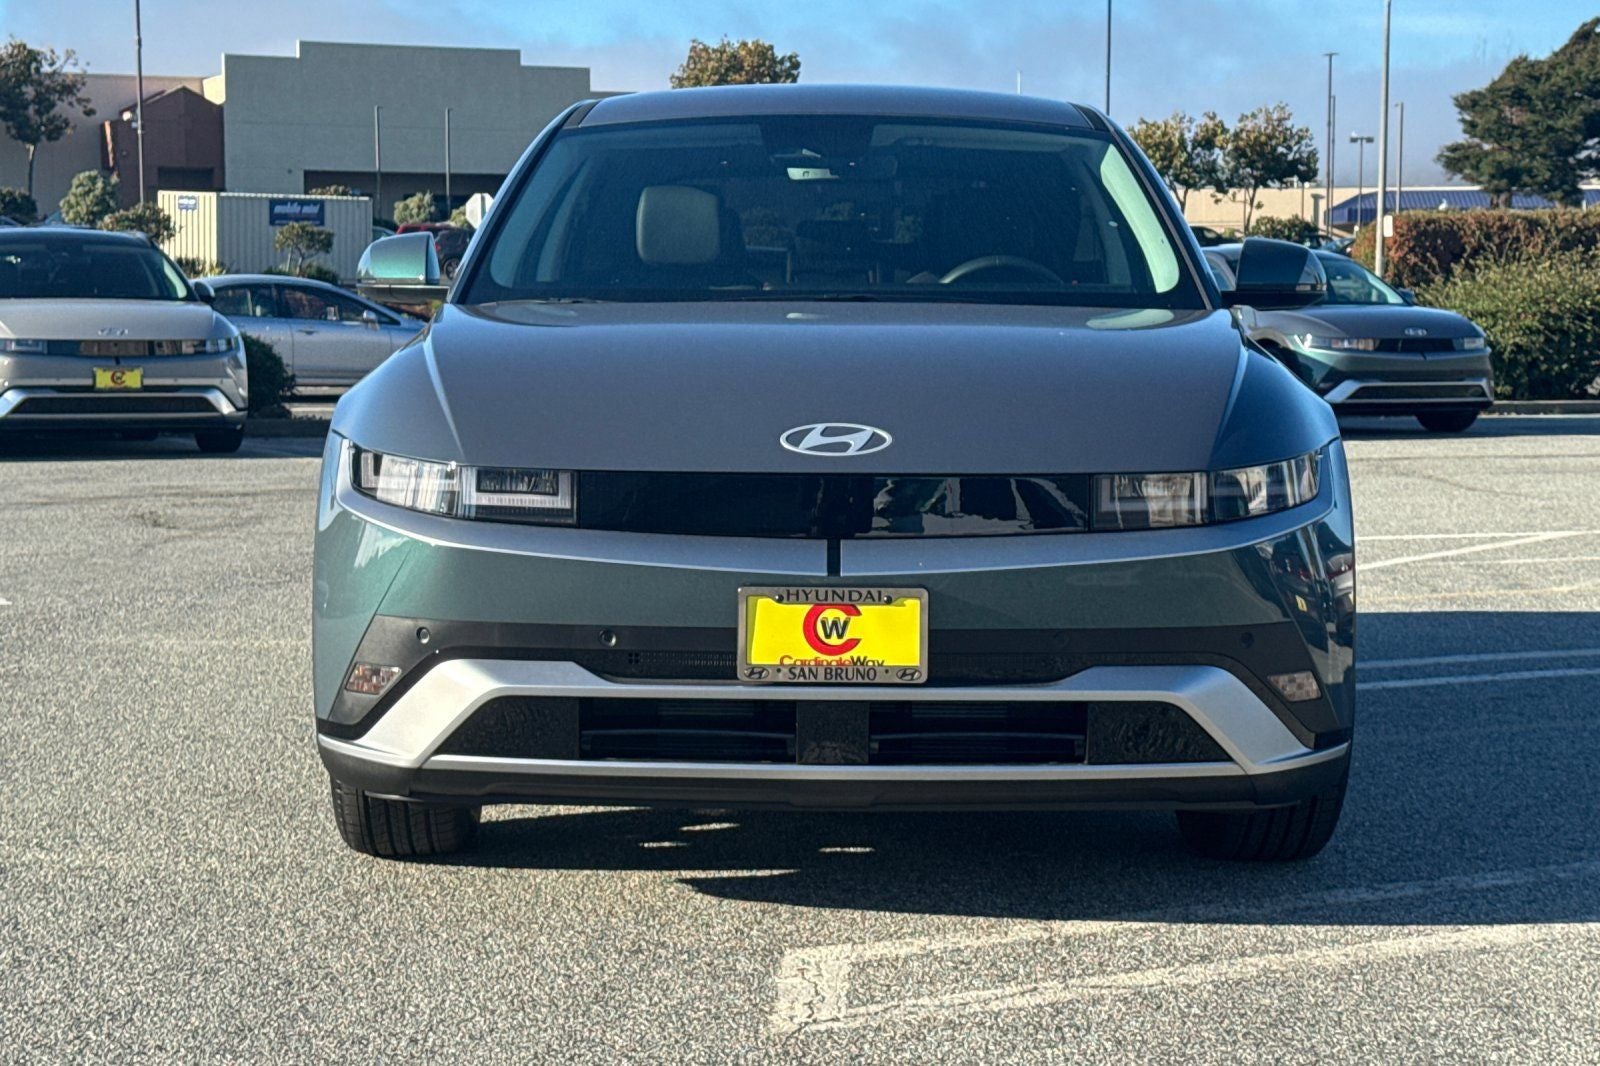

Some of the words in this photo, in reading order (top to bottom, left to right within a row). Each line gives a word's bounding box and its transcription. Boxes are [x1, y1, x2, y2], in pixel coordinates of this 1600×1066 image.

[786, 589, 882, 602] HYUNDAI
[788, 667, 818, 680] SAN
[824, 667, 877, 681] BRUNO
